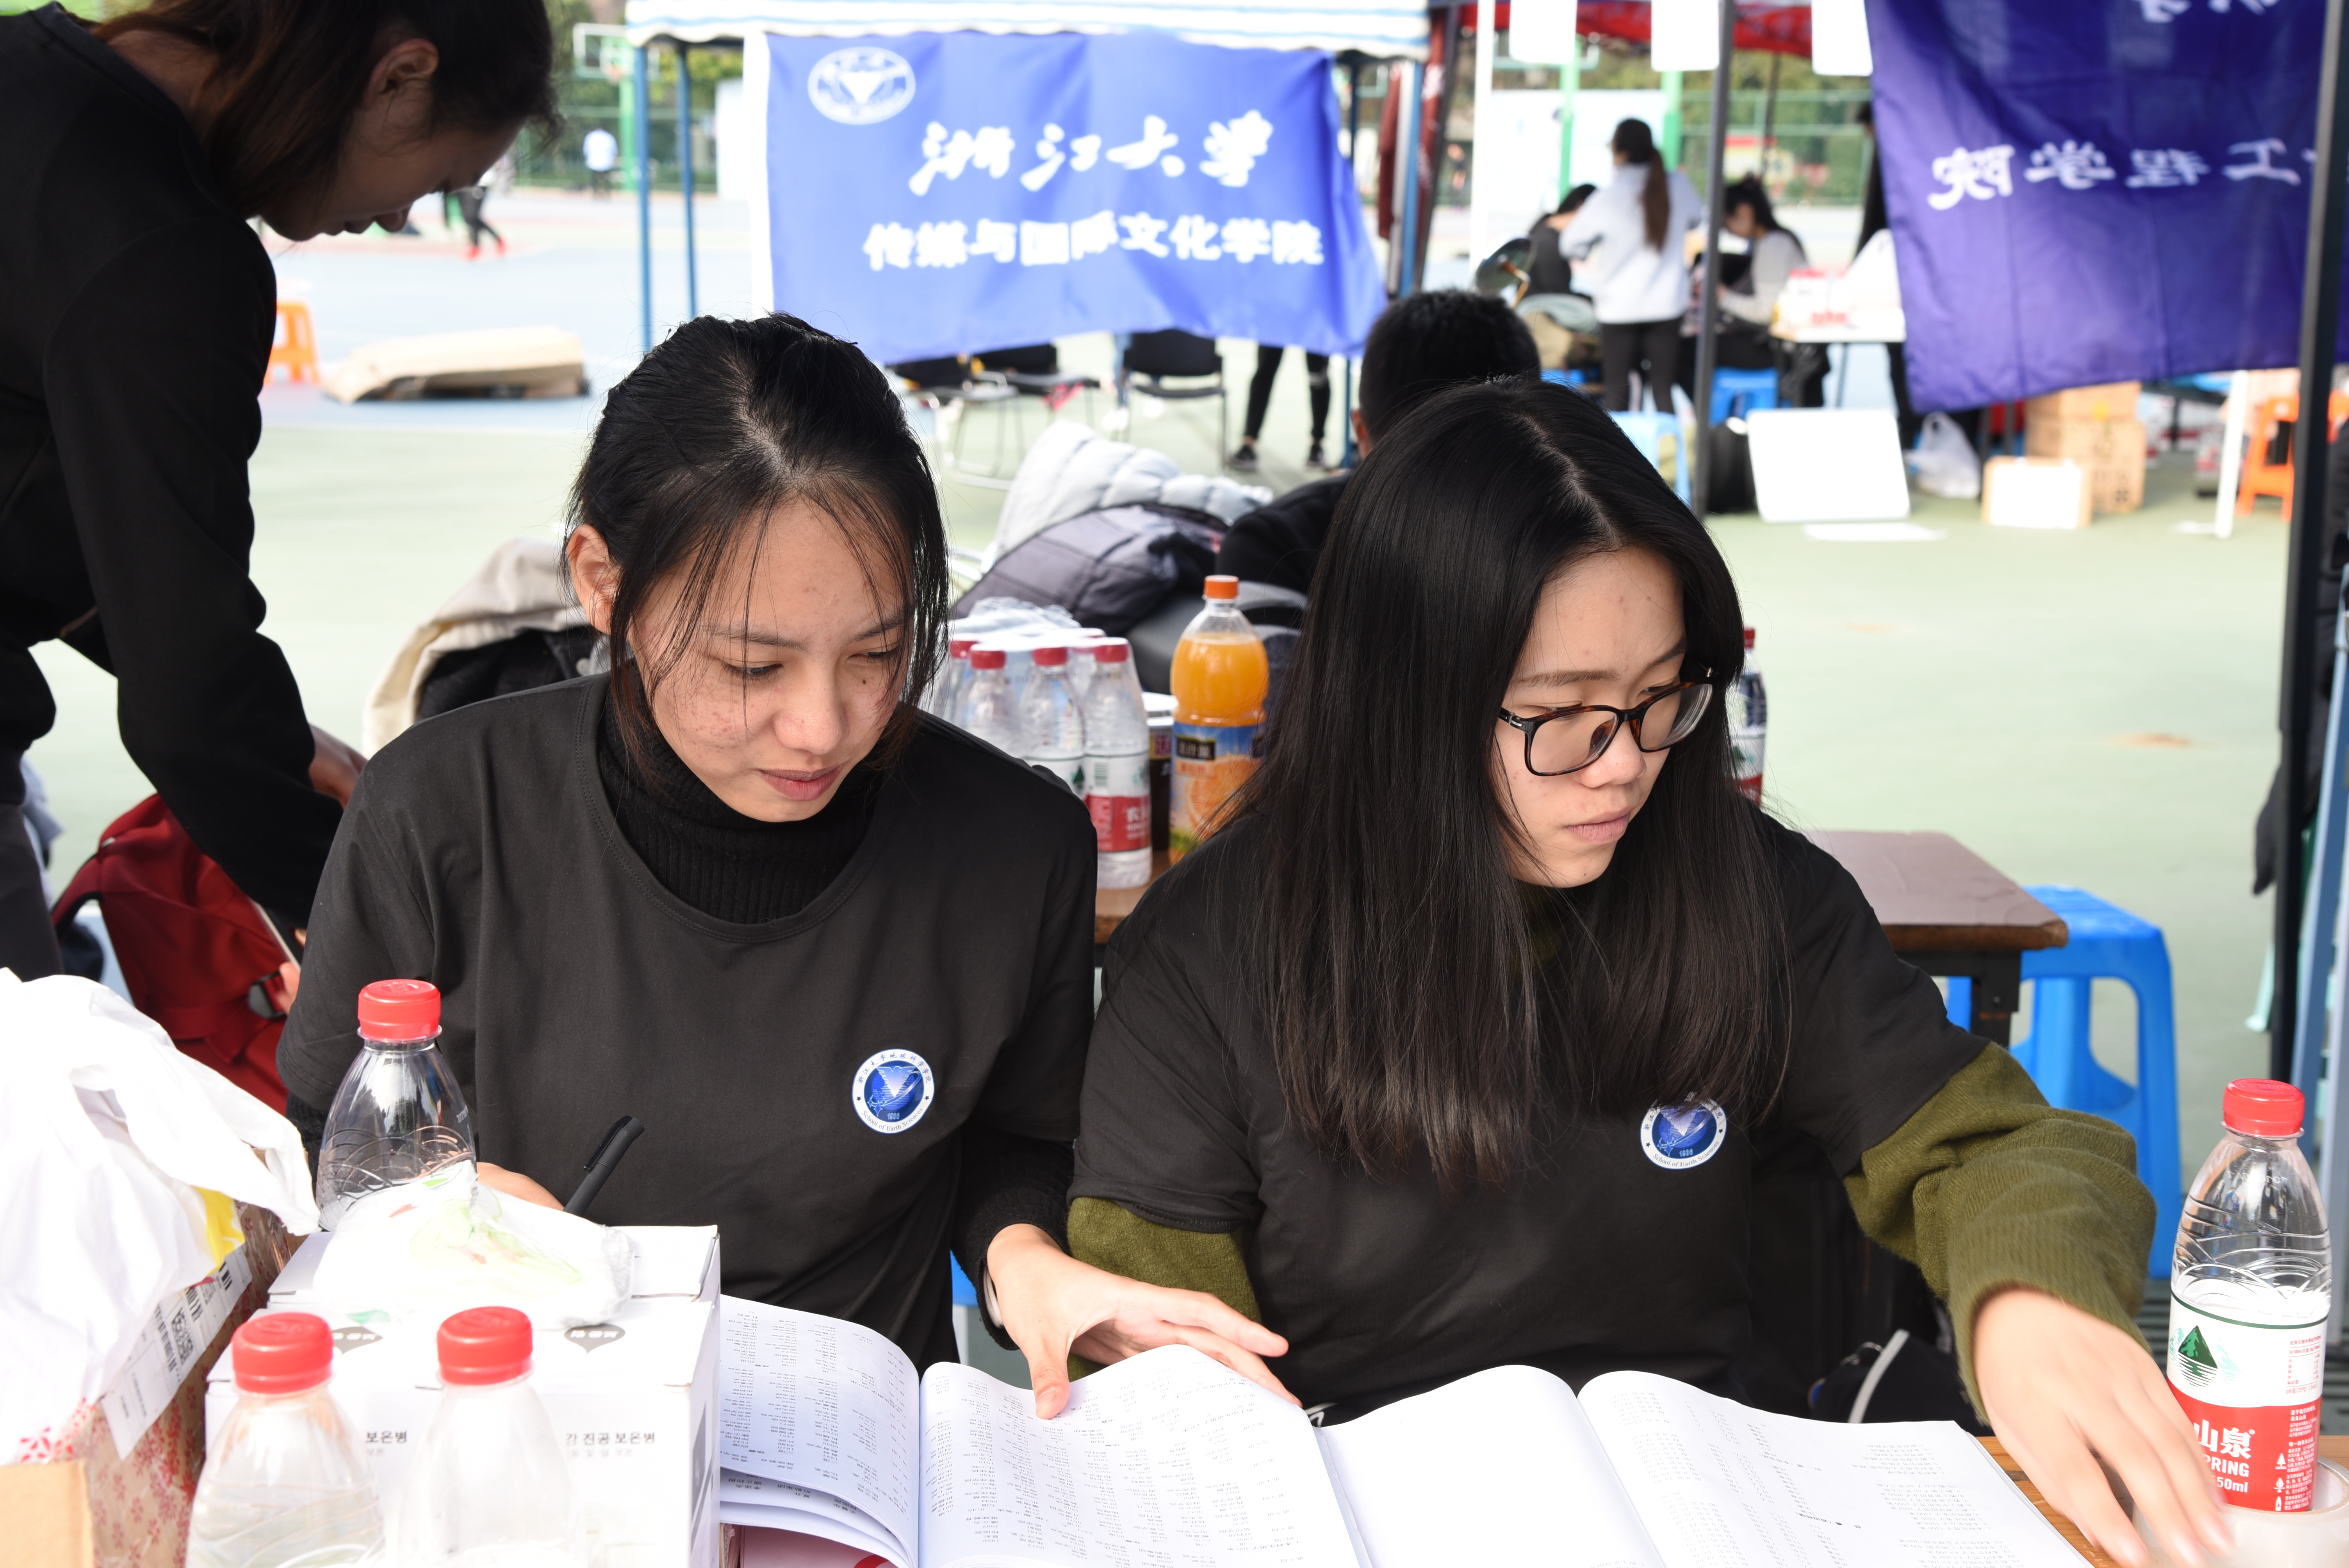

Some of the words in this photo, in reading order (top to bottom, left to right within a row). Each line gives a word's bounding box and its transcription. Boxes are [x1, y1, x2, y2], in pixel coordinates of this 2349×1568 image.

[909, 109, 1274, 197] 浙江大学
[863, 210, 1324, 271] 传媒与国际文化学院
[857, 1052, 932, 1083] 浙江大学地球科学学院
[862, 1110, 878, 1126] School
[902, 1108, 923, 1128] Sciences
[1653, 1154, 1671, 1166] School
[1698, 1141, 1720, 1161] Sciences
[365, 1429, 407, 1443] 보온병
[584, 1432, 610, 1445] 진공
[615, 1431, 655, 1444] 보온병
[2194, 1419, 2251, 1459] 山泉
[2212, 1475, 2248, 1493] 50ml
